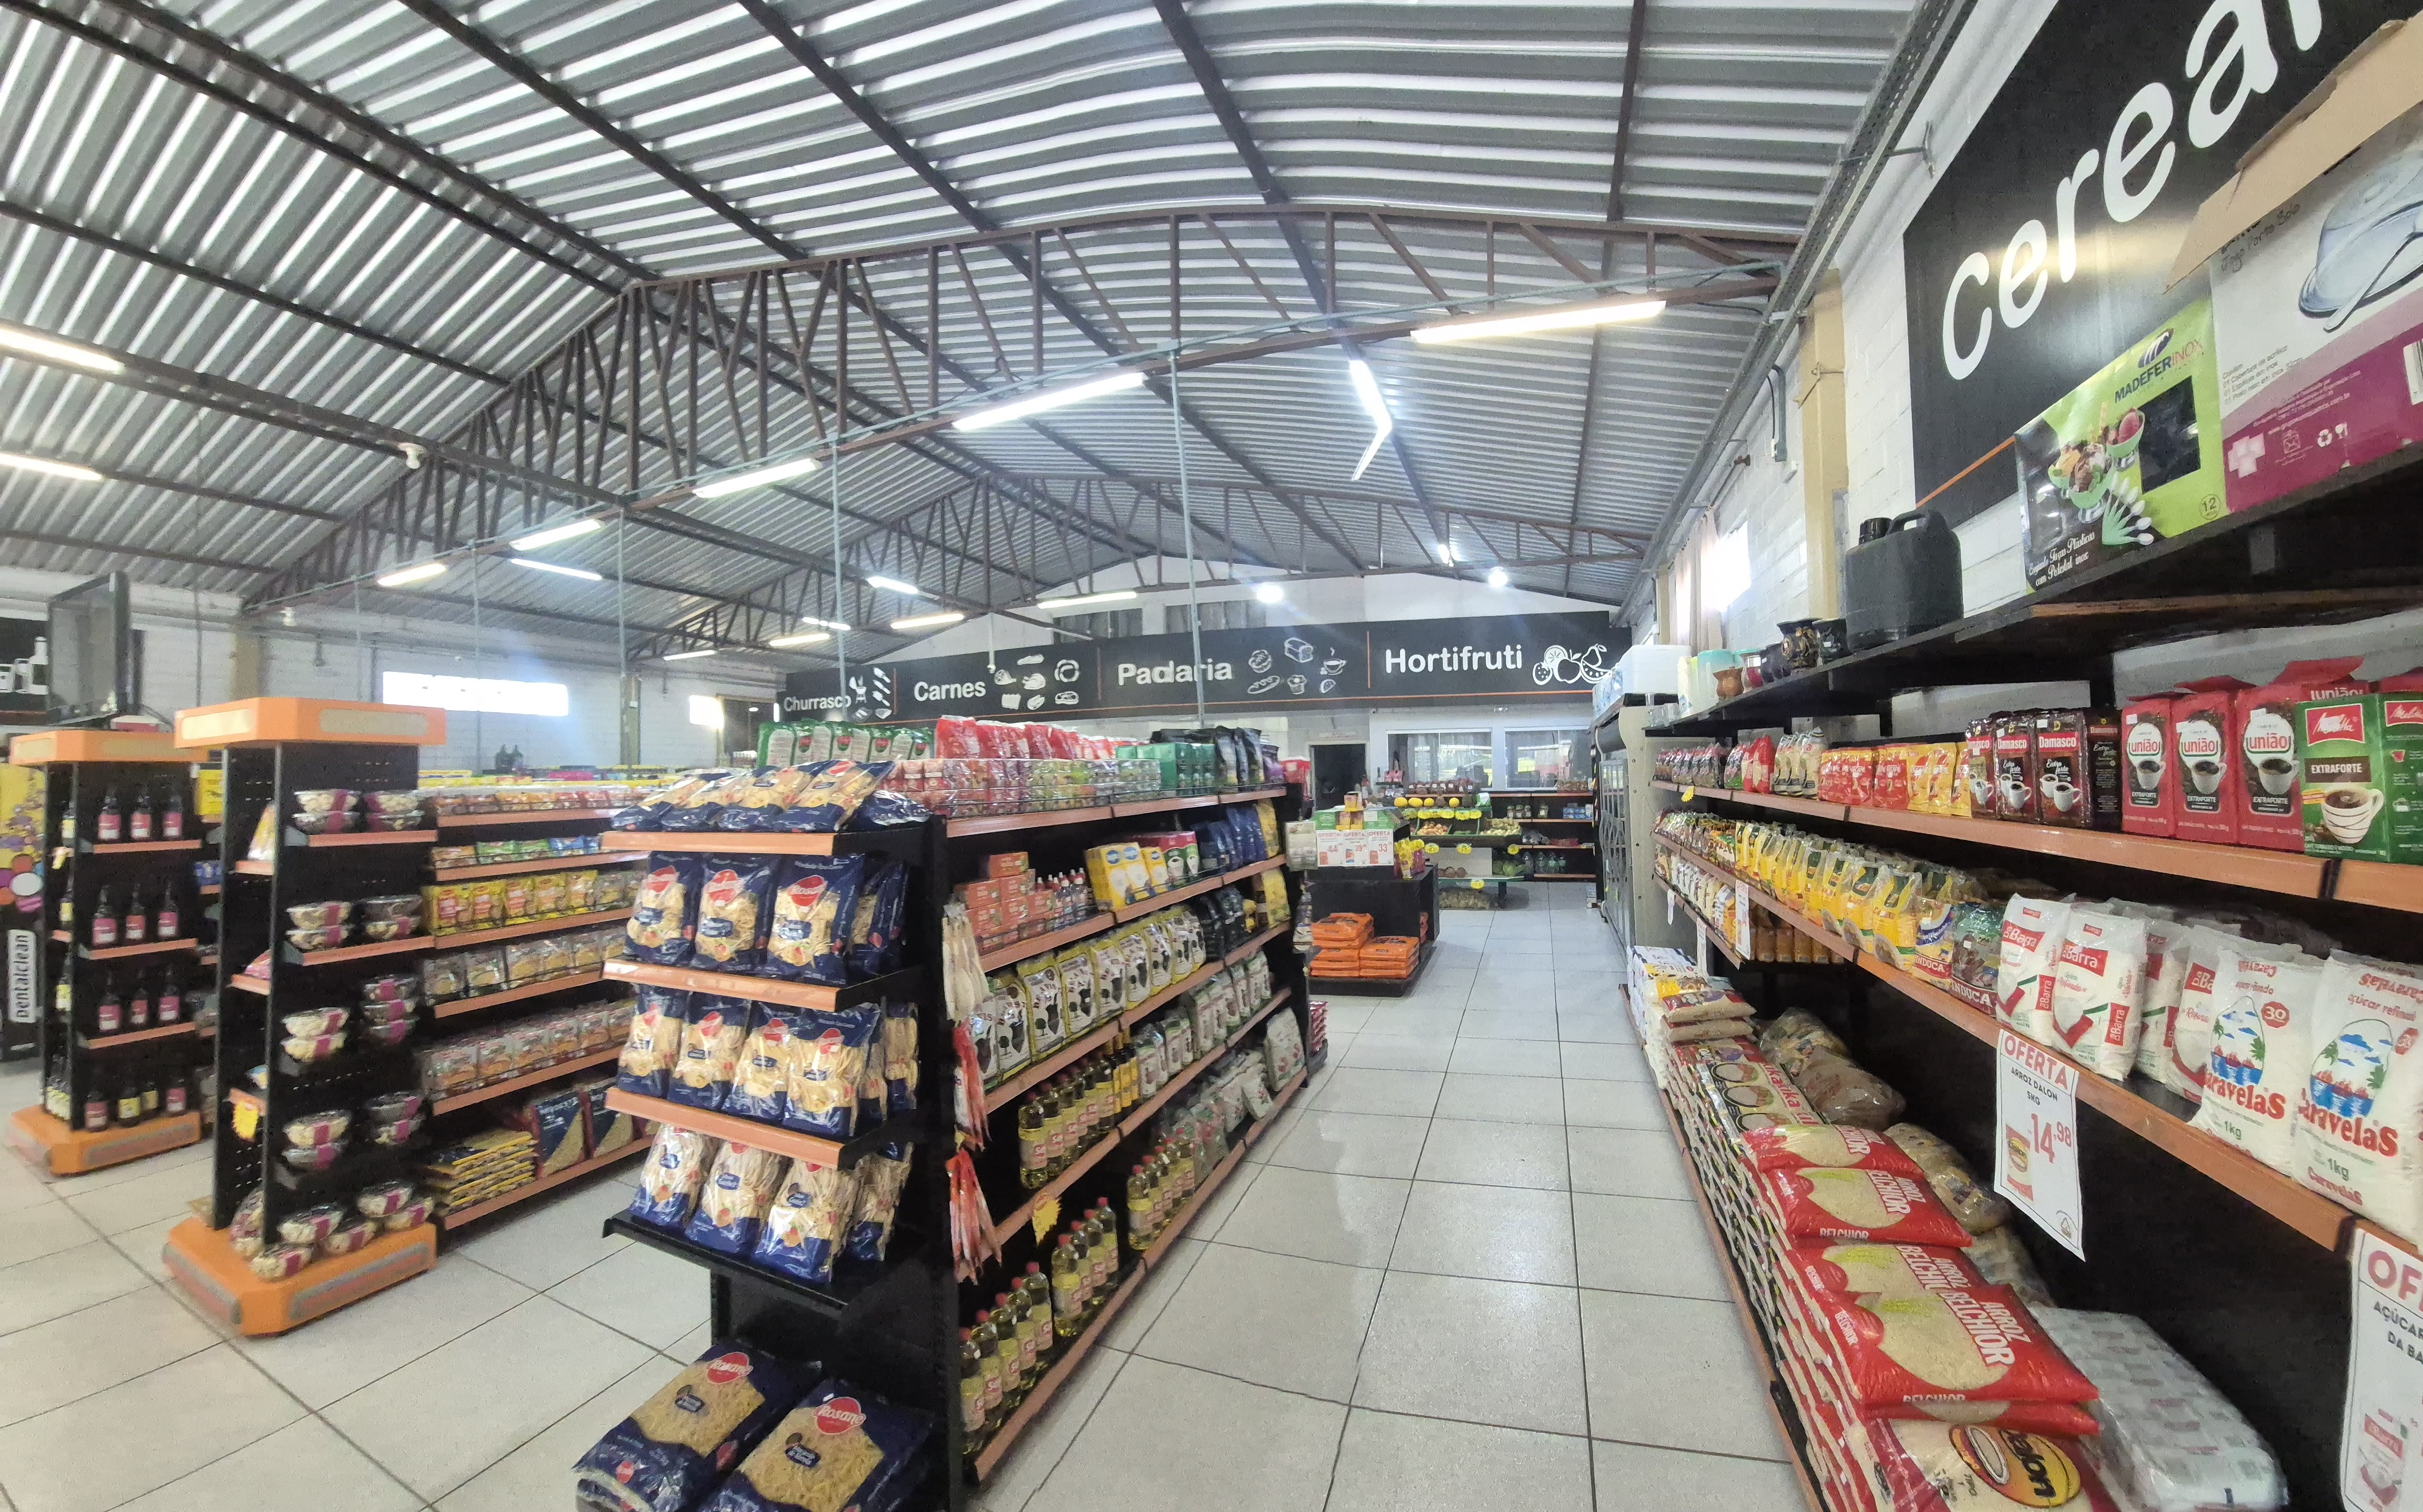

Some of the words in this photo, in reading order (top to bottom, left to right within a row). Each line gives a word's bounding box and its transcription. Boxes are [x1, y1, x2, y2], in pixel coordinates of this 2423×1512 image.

[2202, 497, 2216, 512] 12
[1385, 645, 1523, 673] Hortifruti
[1118, 659, 1234, 686] Padaria
[914, 681, 986, 702] Carnes
[783, 695, 852, 712] Churrasco
[1997, 738, 2027, 750] Damasco
[2039, 736, 2077, 748] Damasco
[2132, 738, 2158, 752] união
[2183, 737, 2215, 753] união
[2249, 733, 2288, 749] união
[2311, 763, 2363, 774] EXTRAFORTE
[2068, 949, 2098, 968] Barra
[2040, 980, 2052, 1003] Barra
[2111, 1009, 2126, 1034] Barra
[2264, 1006, 2287, 1024] 30
[2004, 1035, 2068, 1090] OFERTA
[2011, 1067, 2032, 1086] ARROZ
[2033, 1080, 2058, 1102] DALON
[2027, 1090, 2041, 1106] 5KG
[2224, 1121, 2242, 1141] 1kg
[2327, 1157, 2349, 1182] 1kg
[1931, 1257, 1972, 1289] ARROZ
[2368, 1249, 2423, 1312] OF
[1936, 1292, 2015, 1366] BELCHIOR
[1980, 1302, 2032, 1343] ARROZ
[2387, 1330, 2404, 1351] DA
[818, 1405, 864, 1424] Rosane
